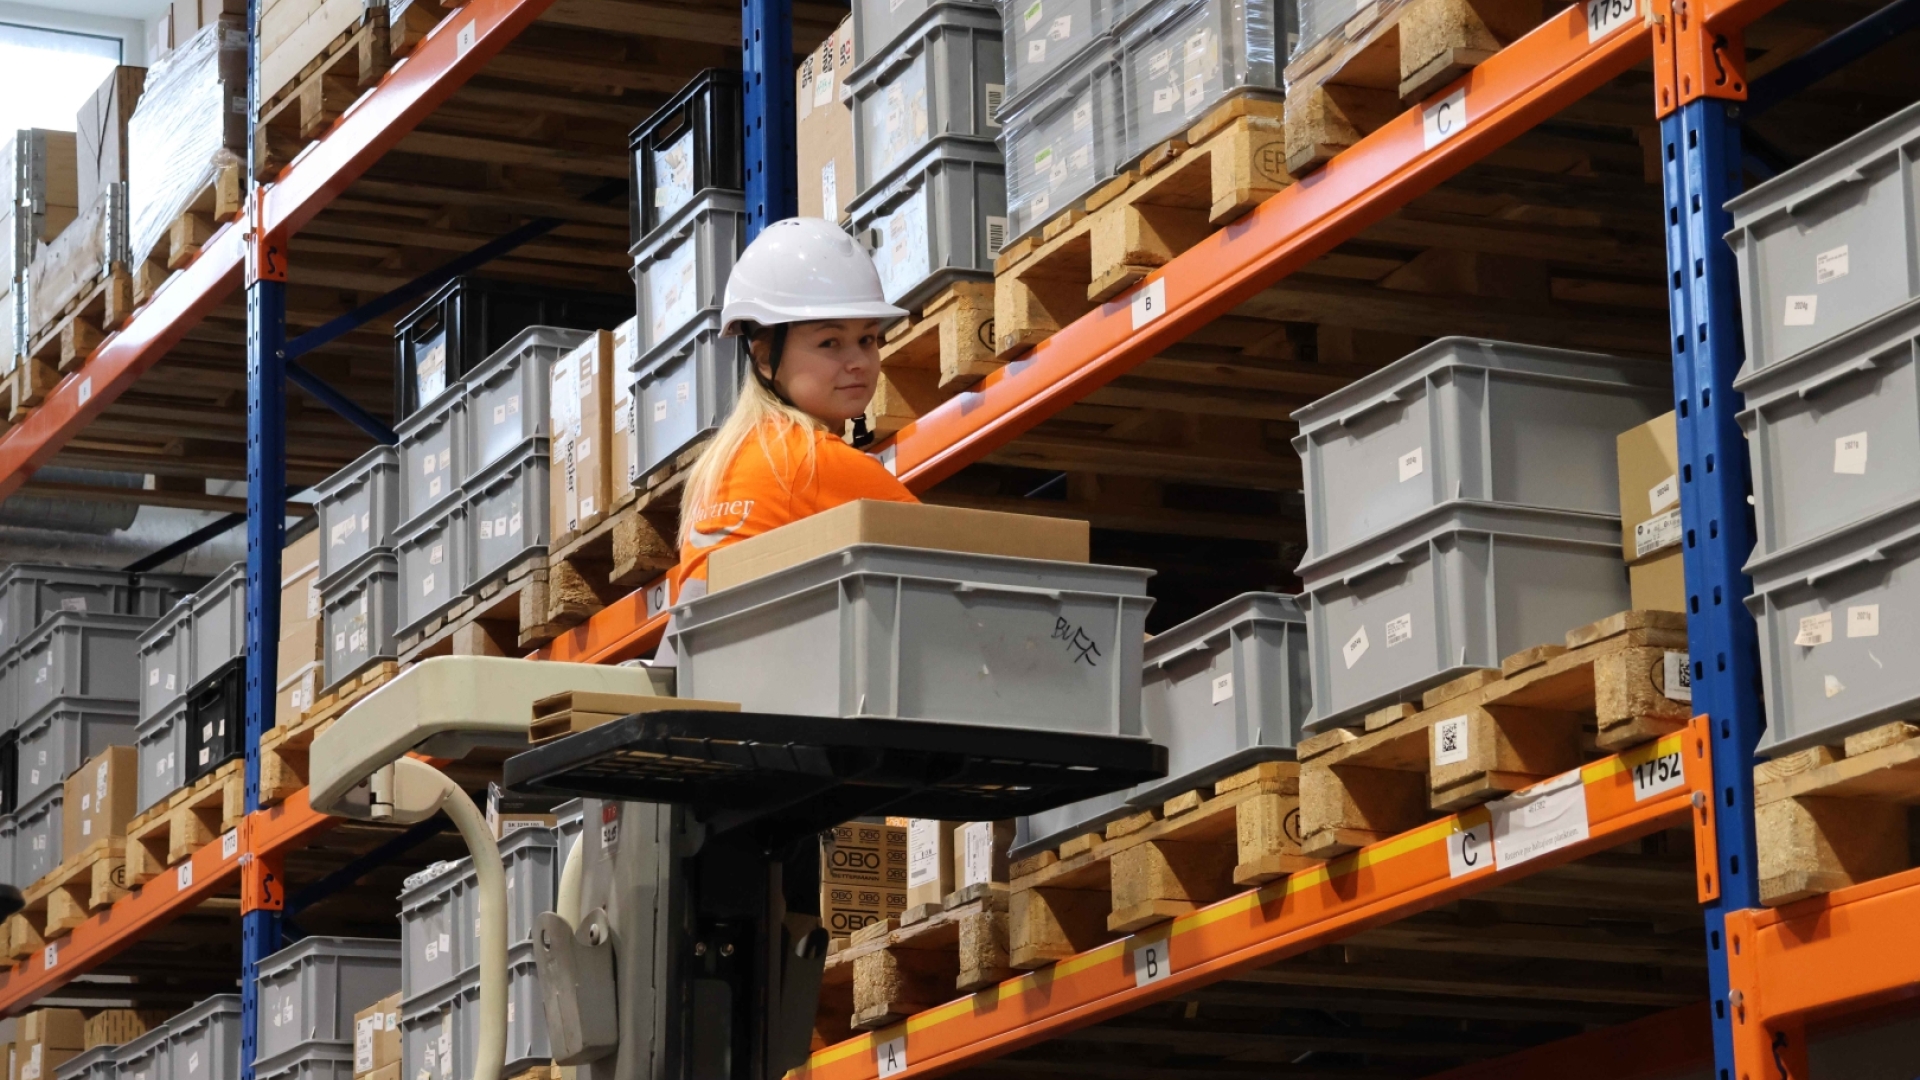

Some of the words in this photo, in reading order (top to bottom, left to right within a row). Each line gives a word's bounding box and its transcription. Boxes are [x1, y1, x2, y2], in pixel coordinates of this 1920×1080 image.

[1437, 102, 1452, 135] C
[1145, 296, 1152, 311] B
[654, 586, 663, 610] C
[1635, 752, 1682, 790] 1752
[858, 831, 880, 839] OBO
[832, 850, 880, 869] OBO
[1461, 832, 1478, 866] C
[182, 866, 188, 885] C
[831, 891, 853, 900] OBO
[858, 892, 880, 902] OBO
[1146, 948, 1158, 979] B
[887, 1043, 898, 1072] A
